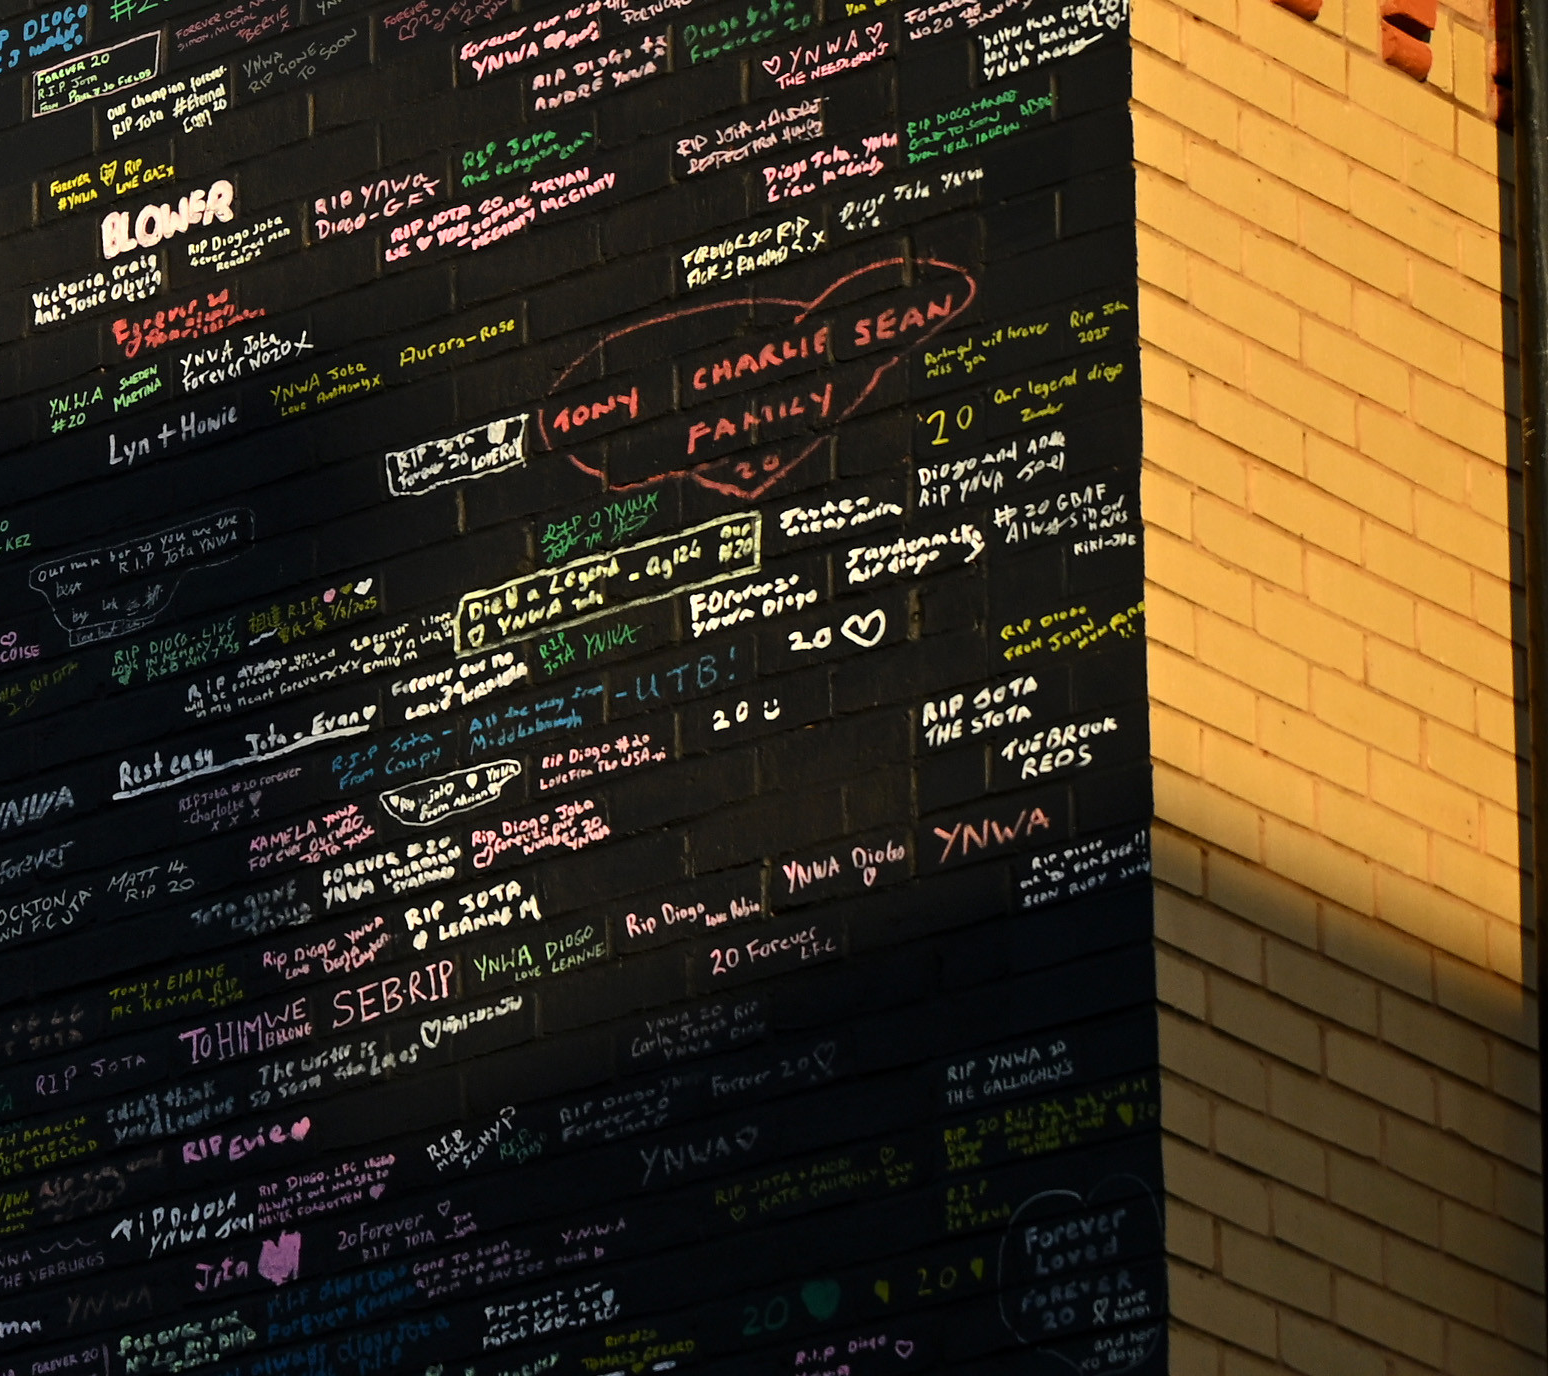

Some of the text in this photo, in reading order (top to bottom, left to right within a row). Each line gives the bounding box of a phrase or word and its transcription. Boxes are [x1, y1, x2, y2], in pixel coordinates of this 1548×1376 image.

[789, 31, 859, 72] YNWA
[101, 175, 238, 259] BLOWER
[554, 295, 951, 432] TONY CHARLIE SEAN
[688, 383, 832, 454] FAMILY
[109, 434, 149, 465] Lyn
[736, 456, 779, 479] 20
[934, 808, 1049, 864] YNWA
[783, 857, 839, 893] YNWA
[710, 948, 739, 975] 20
[640, 1136, 730, 1185] YNWA
